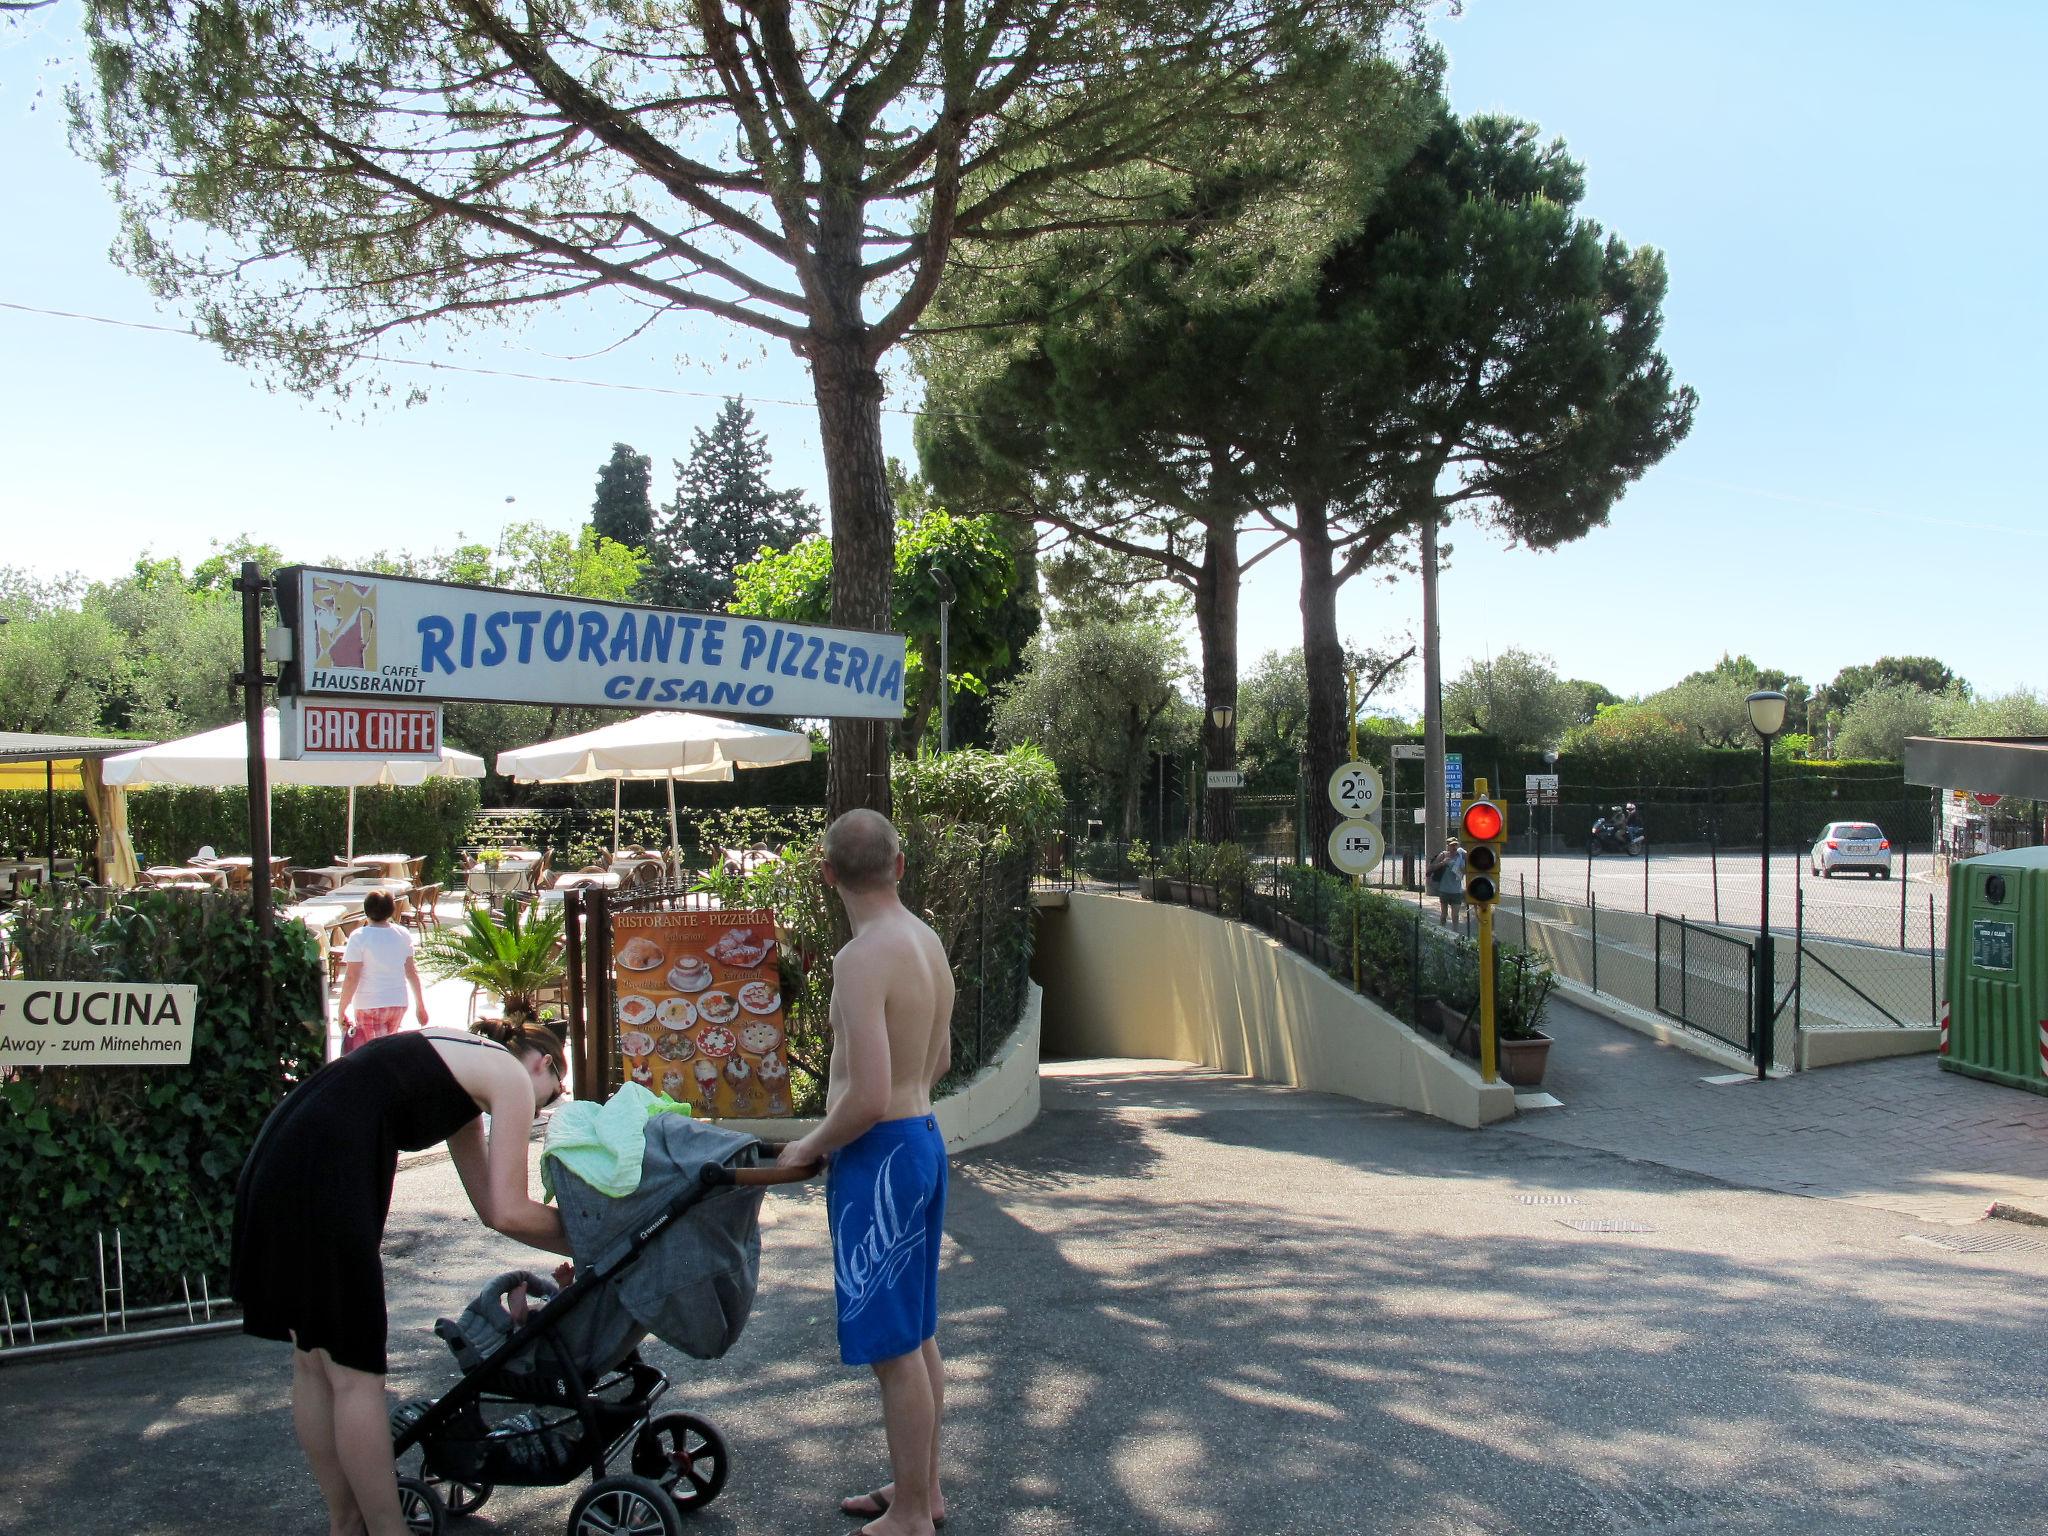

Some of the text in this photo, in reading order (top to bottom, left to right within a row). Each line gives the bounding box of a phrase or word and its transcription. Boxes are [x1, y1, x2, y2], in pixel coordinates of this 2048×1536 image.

[418, 610, 901, 701] RISTORANTE PIZZERIA
[311, 671, 426, 693] HAUSBRANDT
[604, 675, 774, 706] CISANO
[306, 710, 360, 749] BAR
[1341, 779, 1355, 799] 2
[1358, 790, 1372, 799] 00
[618, 915, 698, 928] RISTORANTE
[709, 913, 769, 925] PIZZERIA
[23, 991, 182, 1025] CUCINA
[0, 1036, 45, 1055] Away
[62, 1040, 95, 1051] zum
[100, 1036, 182, 1051] Mitnehmen
